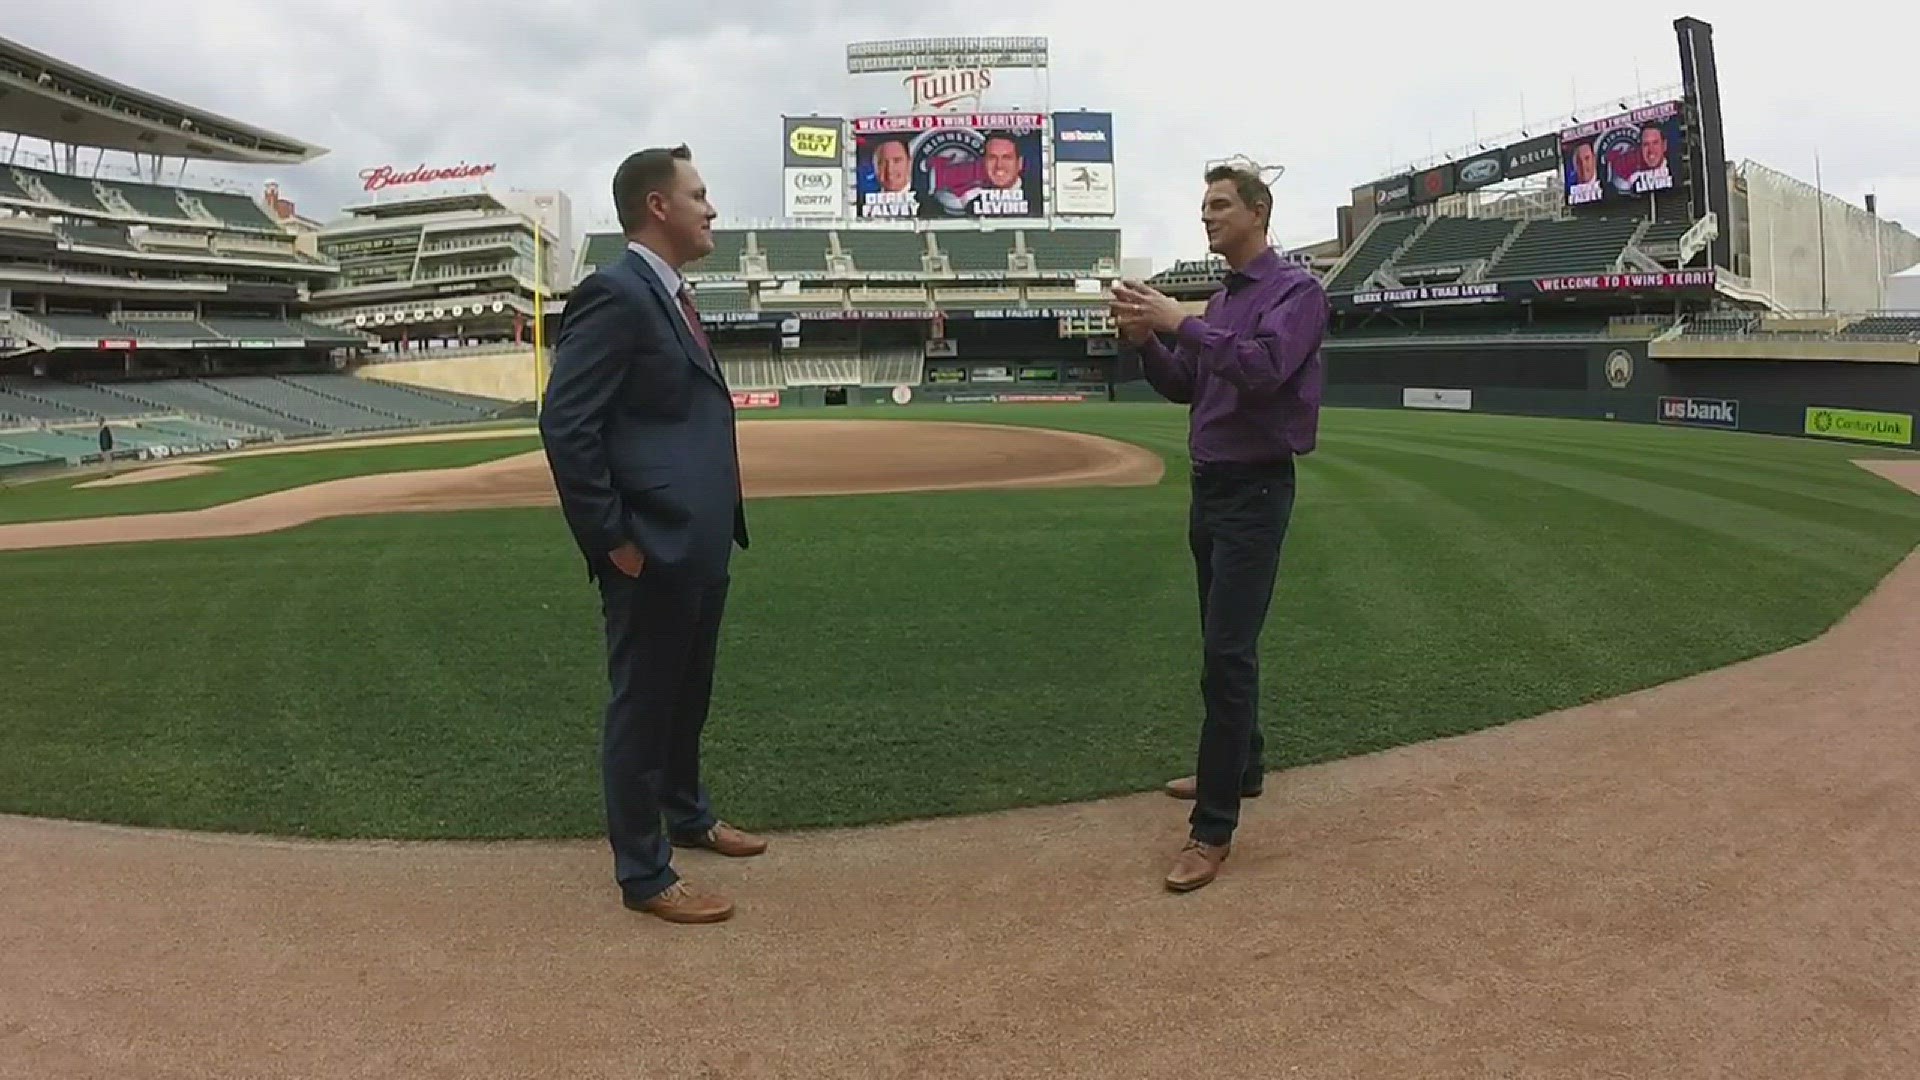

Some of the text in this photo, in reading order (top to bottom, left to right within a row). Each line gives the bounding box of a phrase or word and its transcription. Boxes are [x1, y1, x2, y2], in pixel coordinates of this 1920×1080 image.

[902, 68, 992, 107] Twins
[859, 114, 1038, 129] WELCOME TO TWINS TERRITORY
[797, 133, 834, 143] BEST
[798, 142, 829, 152] BUY
[1520, 148, 1554, 164] DELTA
[359, 160, 496, 191] Budweiser
[802, 175, 823, 184] FOX
[1643, 167, 1669, 180] THAD
[1636, 176, 1673, 192] LEVINE
[795, 196, 832, 205] NORTH
[865, 192, 916, 203] DEREK
[981, 189, 1023, 200] THAD
[1568, 189, 1603, 205] FALVEY
[862, 203, 920, 216] FALVEY
[974, 201, 1028, 214] LEVINE
[1543, 277, 1599, 290] WELCOME
[1603, 276, 1620, 287] TO
[1624, 274, 1664, 286] TWINS
[1353, 292, 1382, 304] DEREK
[1384, 289, 1419, 301] FALVEY
[1420, 287, 1428, 298] &
[1431, 286, 1459, 297] THAD
[1461, 283, 1499, 296] LEVINE
[726, 312, 759, 321] LEVINE
[1006, 309, 1040, 318] FALVEY
[1835, 417, 1903, 436] CenturyLink
